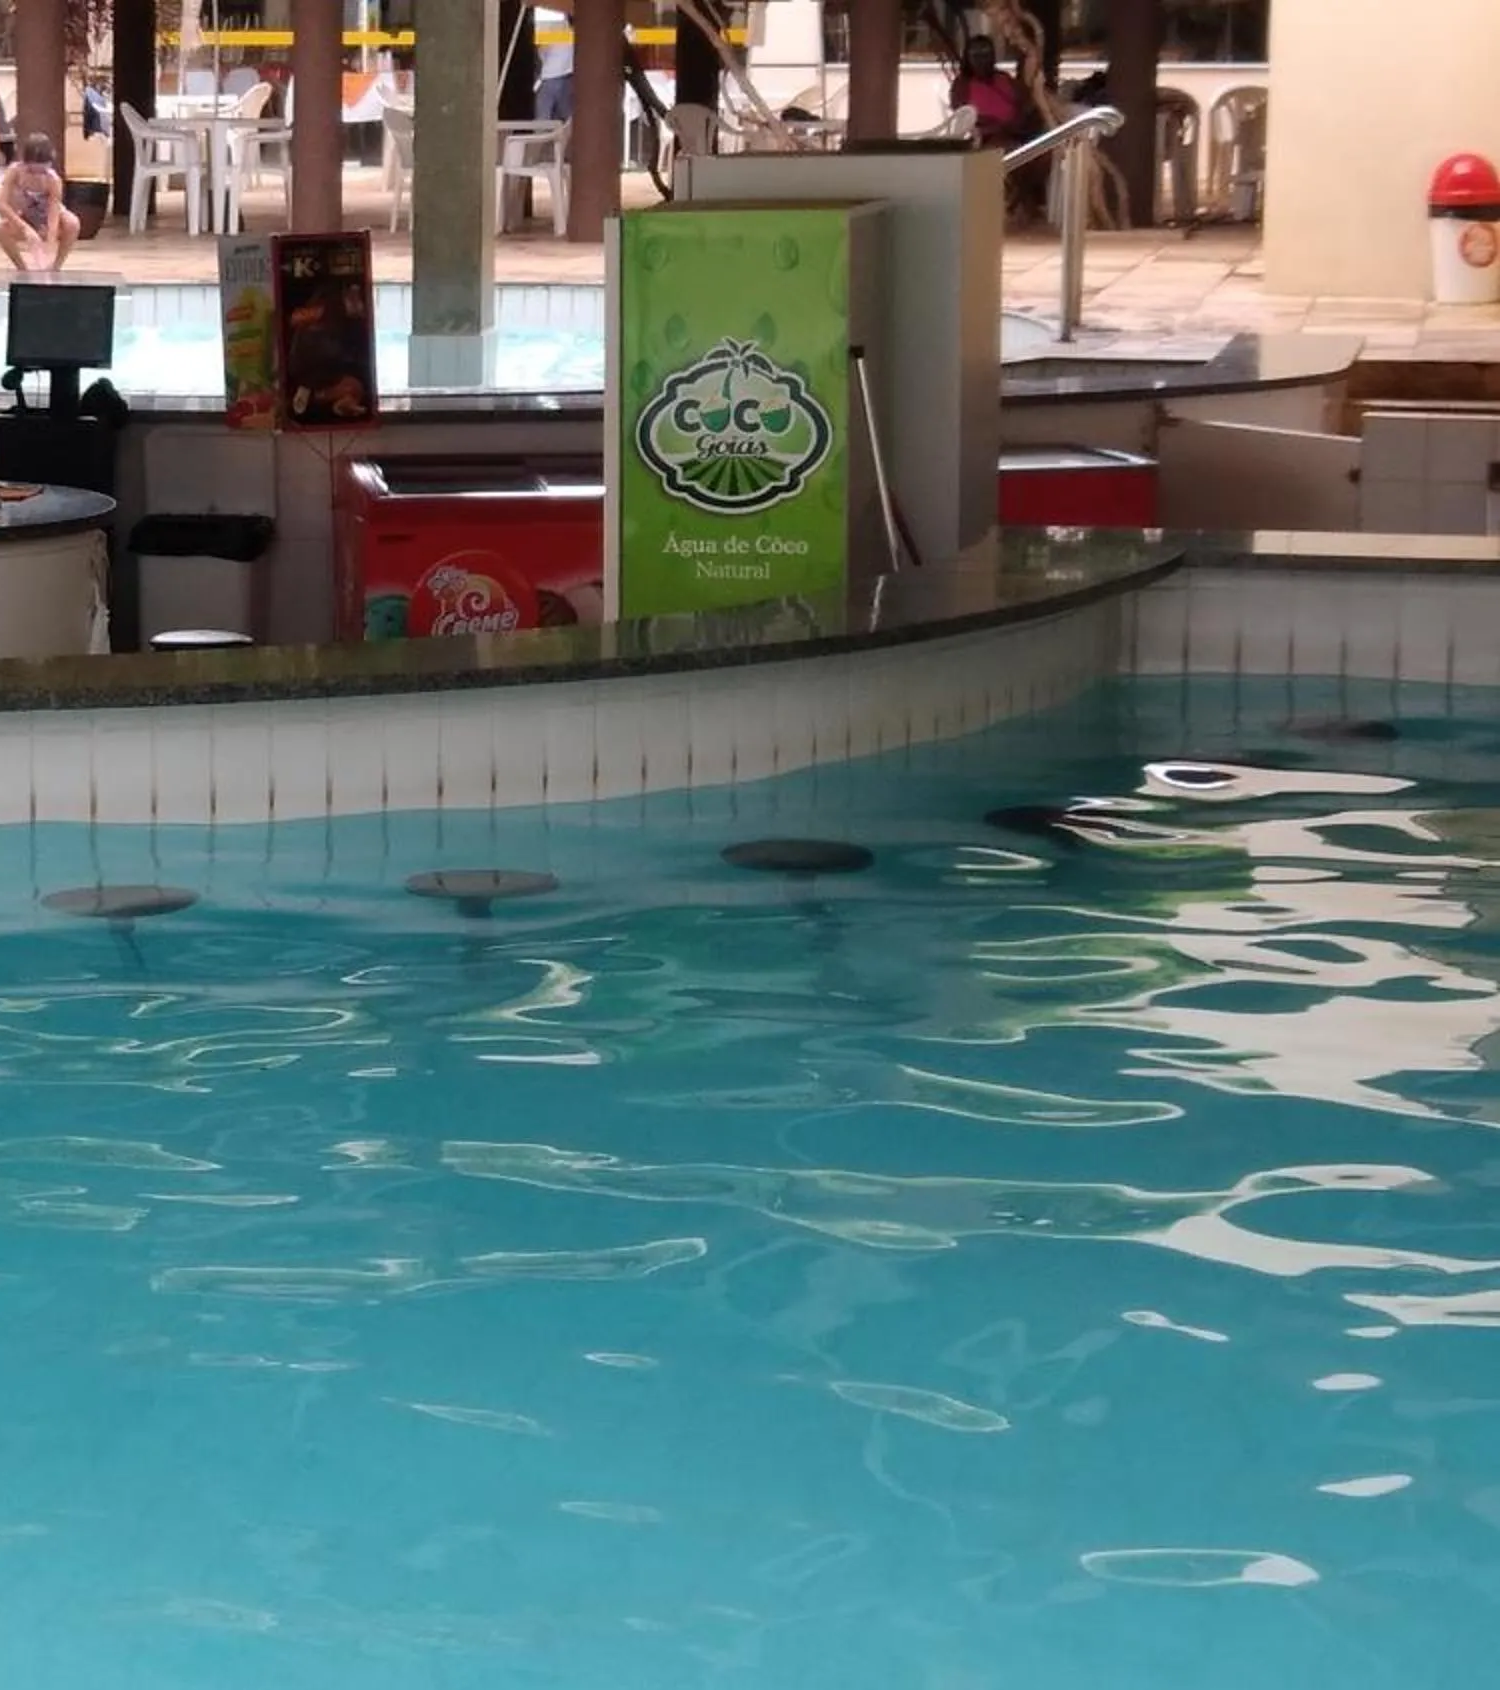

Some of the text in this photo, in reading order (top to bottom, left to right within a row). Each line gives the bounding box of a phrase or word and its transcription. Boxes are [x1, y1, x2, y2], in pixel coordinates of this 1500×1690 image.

[696, 434, 768, 459] Goiás
[662, 530, 810, 558] Água de Côco
[695, 560, 771, 580] Natural
